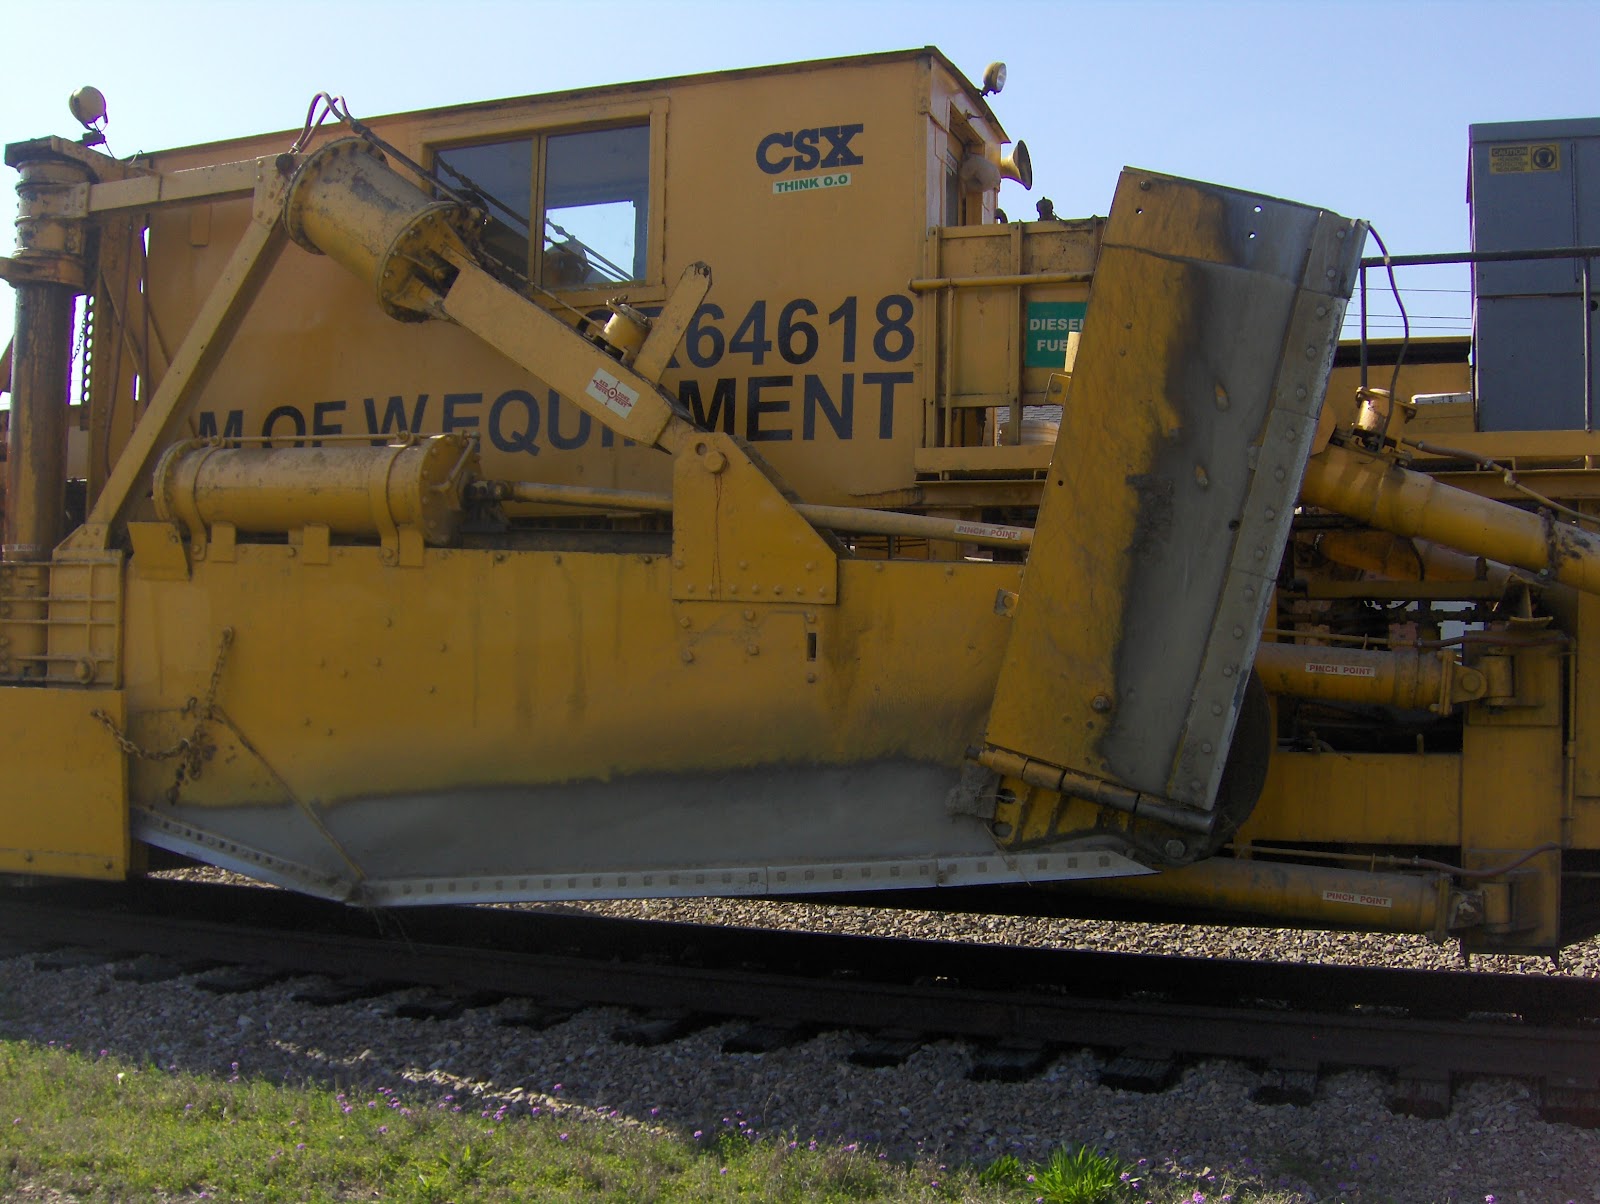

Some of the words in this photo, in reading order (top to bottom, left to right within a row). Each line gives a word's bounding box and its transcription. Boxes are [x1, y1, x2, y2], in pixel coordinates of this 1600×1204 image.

[756, 123, 864, 175] CSX
[1493, 147, 1528, 157] CAUTION
[776, 177, 819, 192] THINK
[577, 294, 915, 369] 64618
[1037, 339, 1068, 352] FUE
[199, 409, 243, 449] M
[261, 400, 346, 449] OF
[363, 394, 429, 447] W
[442, 371, 914, 457] EQUMENT
[958, 525, 986, 536] PINCH
[990, 529, 1018, 539] POINT
[1309, 664, 1338, 673] PINCH
[1343, 666, 1371, 675] POINT
[1326, 892, 1355, 902] PINCH
[1360, 895, 1389, 905] POINT
